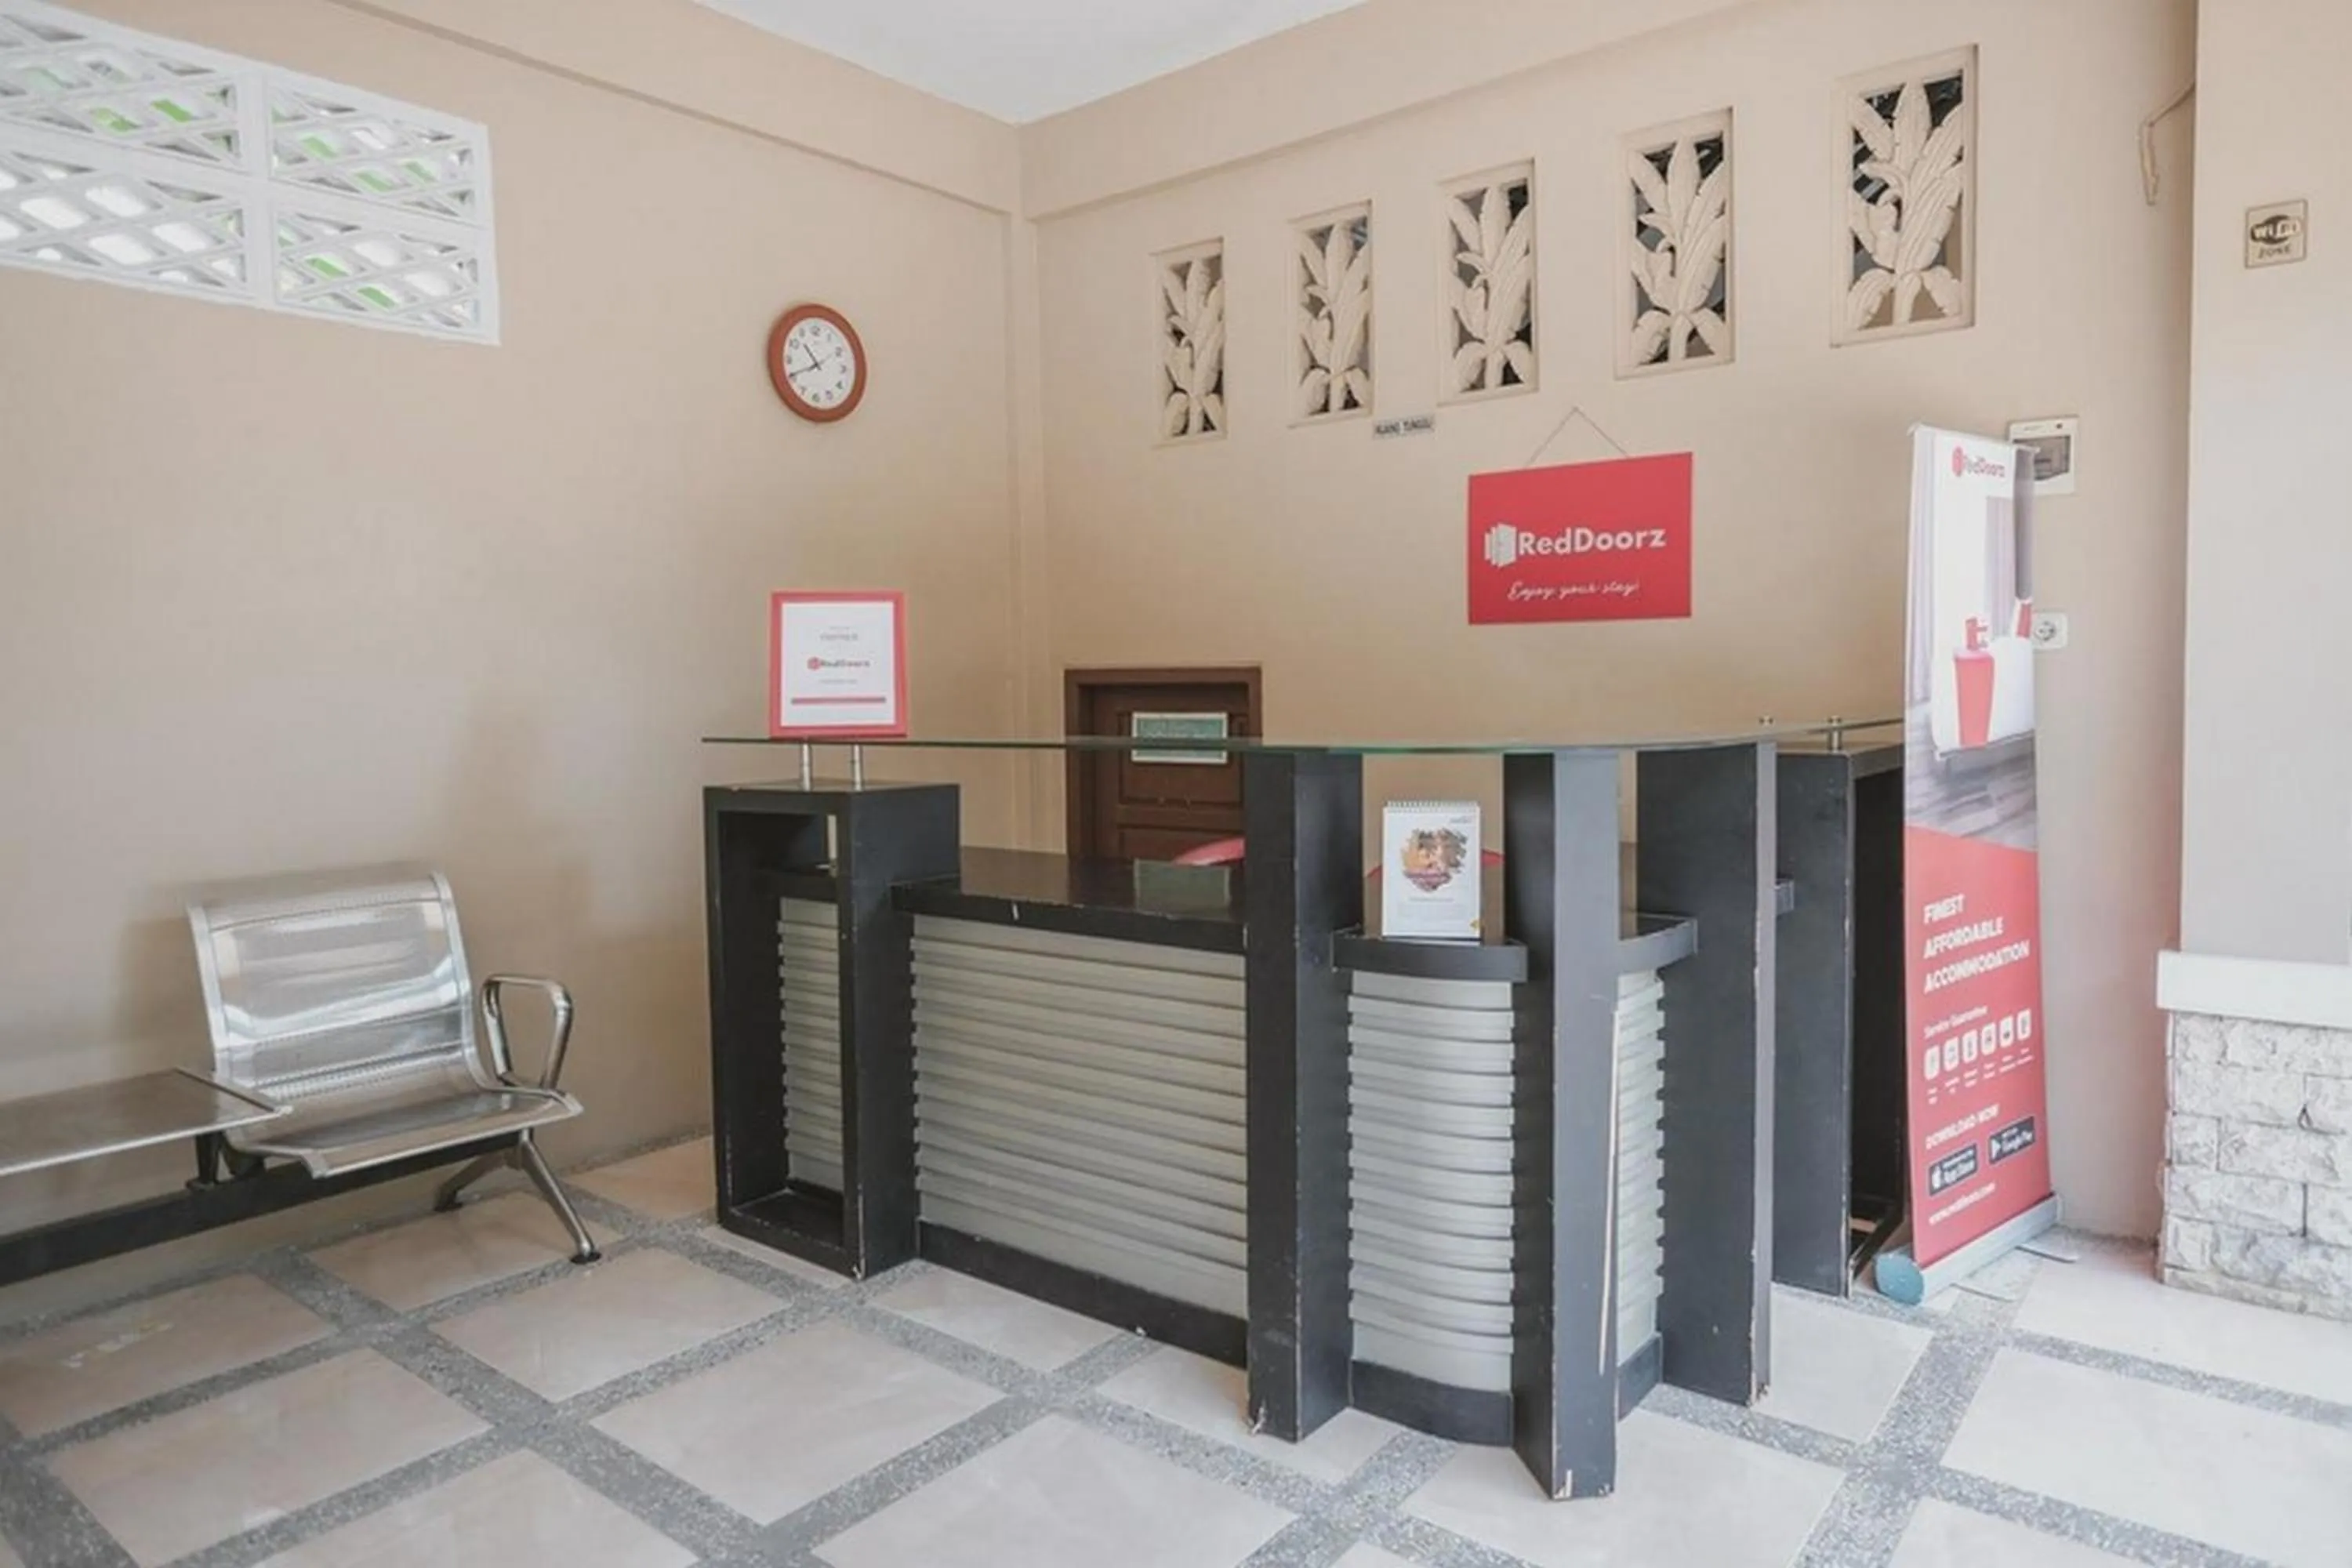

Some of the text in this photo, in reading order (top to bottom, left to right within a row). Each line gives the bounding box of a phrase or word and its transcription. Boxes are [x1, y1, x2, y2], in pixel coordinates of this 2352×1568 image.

[1519, 526, 1667, 555] RedDoorz
[1507, 581, 1555, 601] Enjoy
[1558, 583, 1596, 600] your
[1923, 893, 1965, 924] FINEST
[1923, 916, 2004, 960] AFFORDABLE
[1926, 1104, 1999, 1151] DOWNLOAD NOW
